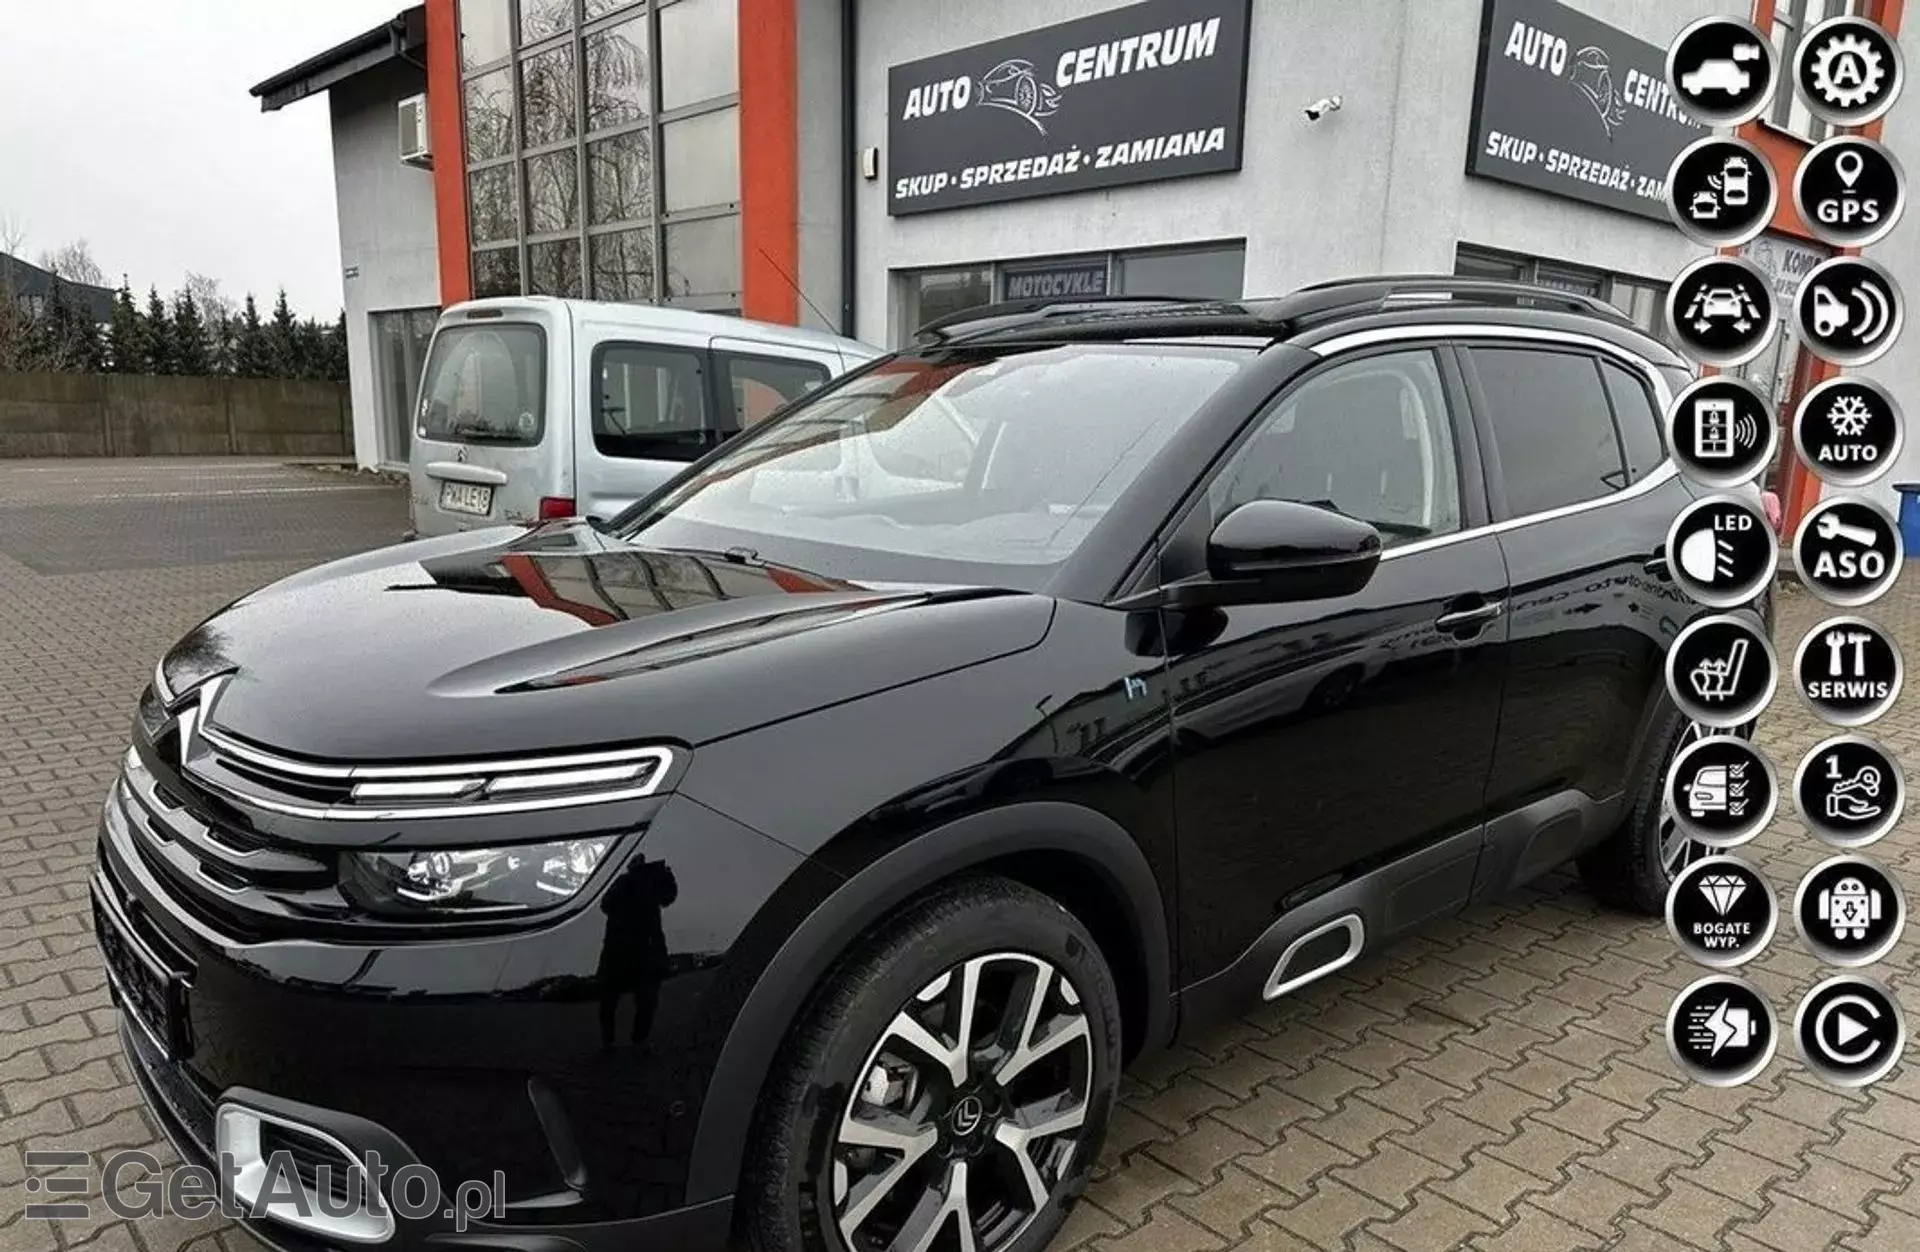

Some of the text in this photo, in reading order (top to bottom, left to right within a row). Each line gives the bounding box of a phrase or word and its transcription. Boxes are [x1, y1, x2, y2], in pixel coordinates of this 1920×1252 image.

[902, 17, 1221, 121] AUTO CENTRUM
[1504, 21, 1568, 77] AUTO
[895, 171, 947, 200] SKUP
[1094, 127, 1226, 169] ZAMIANA
[1485, 130, 1537, 165] SKUP
[1007, 269, 1106, 299] MOTOCYKLE
